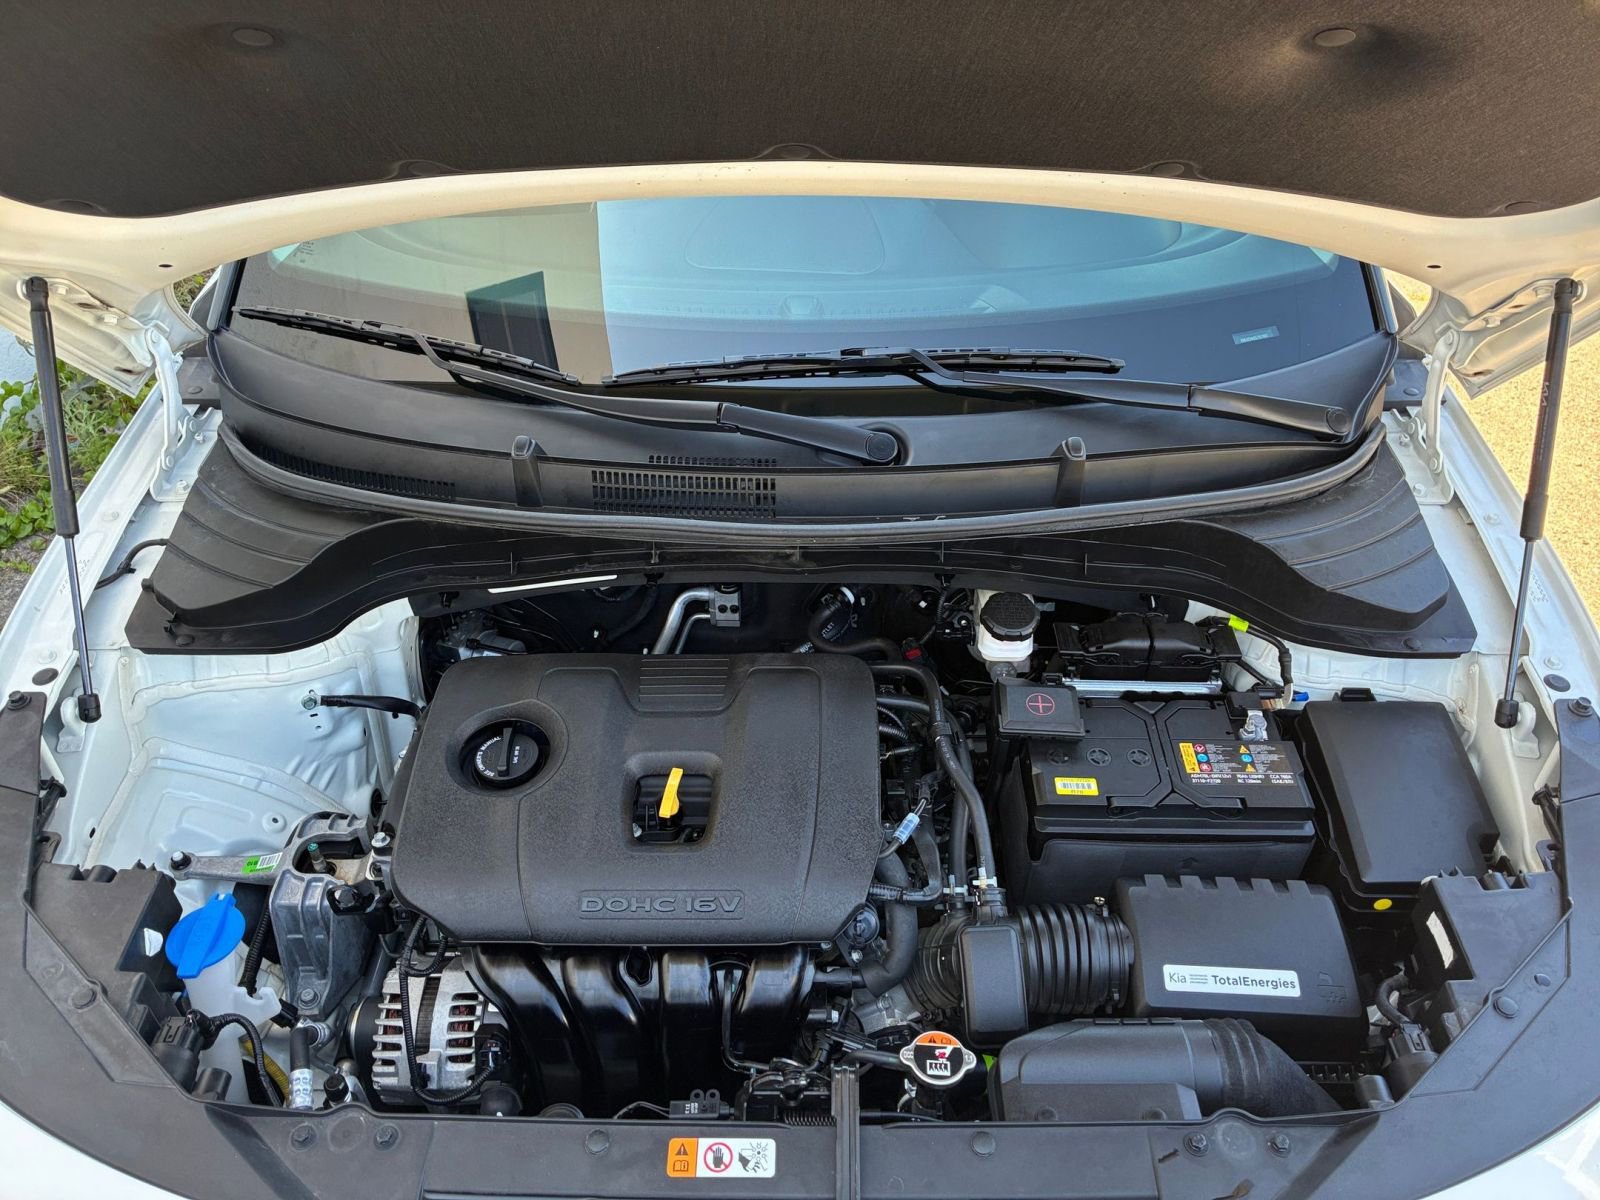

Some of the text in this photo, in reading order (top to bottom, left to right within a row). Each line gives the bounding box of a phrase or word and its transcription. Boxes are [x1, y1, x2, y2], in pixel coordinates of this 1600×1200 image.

[480, 736, 501, 751] MANUAL
[580, 896, 741, 912] DOHC 16V
[1168, 972, 1297, 990] Kia TotalEnergies
